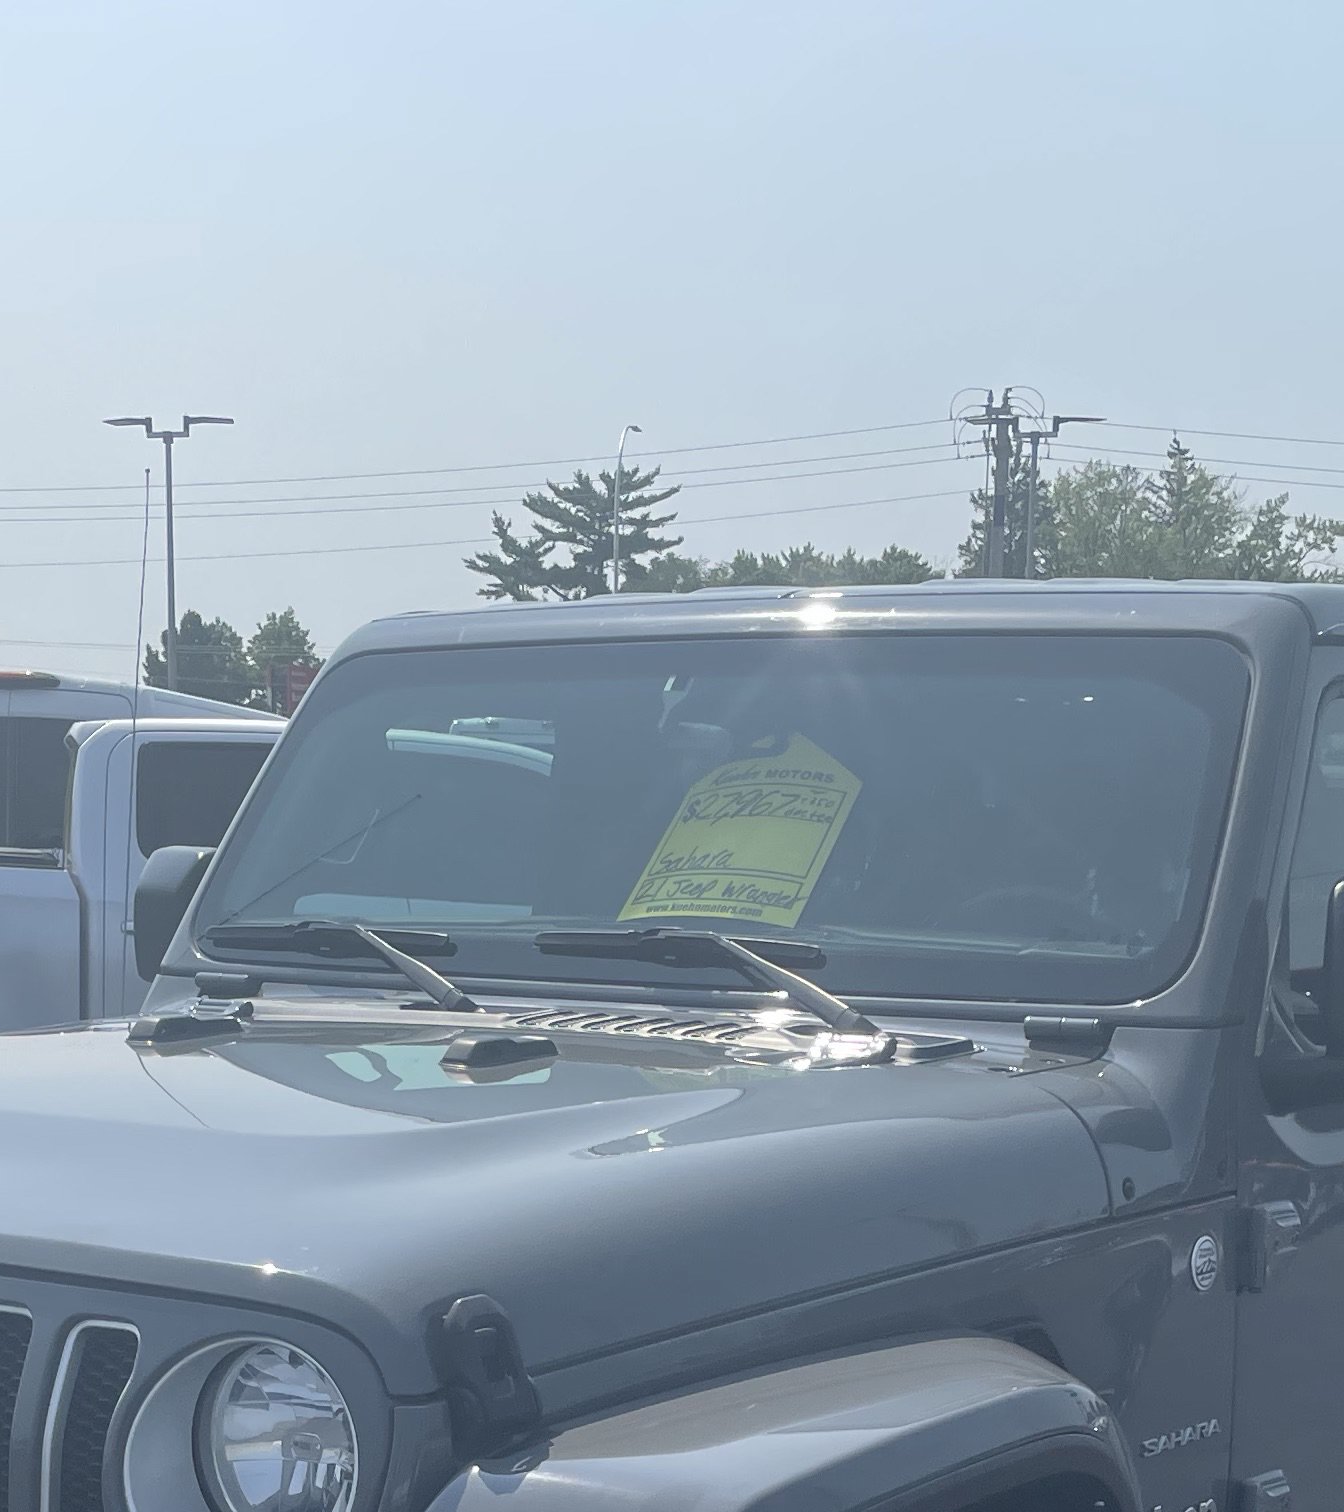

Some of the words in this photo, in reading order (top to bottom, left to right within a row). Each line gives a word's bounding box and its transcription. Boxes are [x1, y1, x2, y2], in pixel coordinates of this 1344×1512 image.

[764, 769, 835, 784] MOTORS
[659, 846, 734, 873] Sahara
[666, 879, 719, 899] Jeep
[721, 880, 807, 907] Wrangler
[1142, 1418, 1222, 1458] SAHARA
